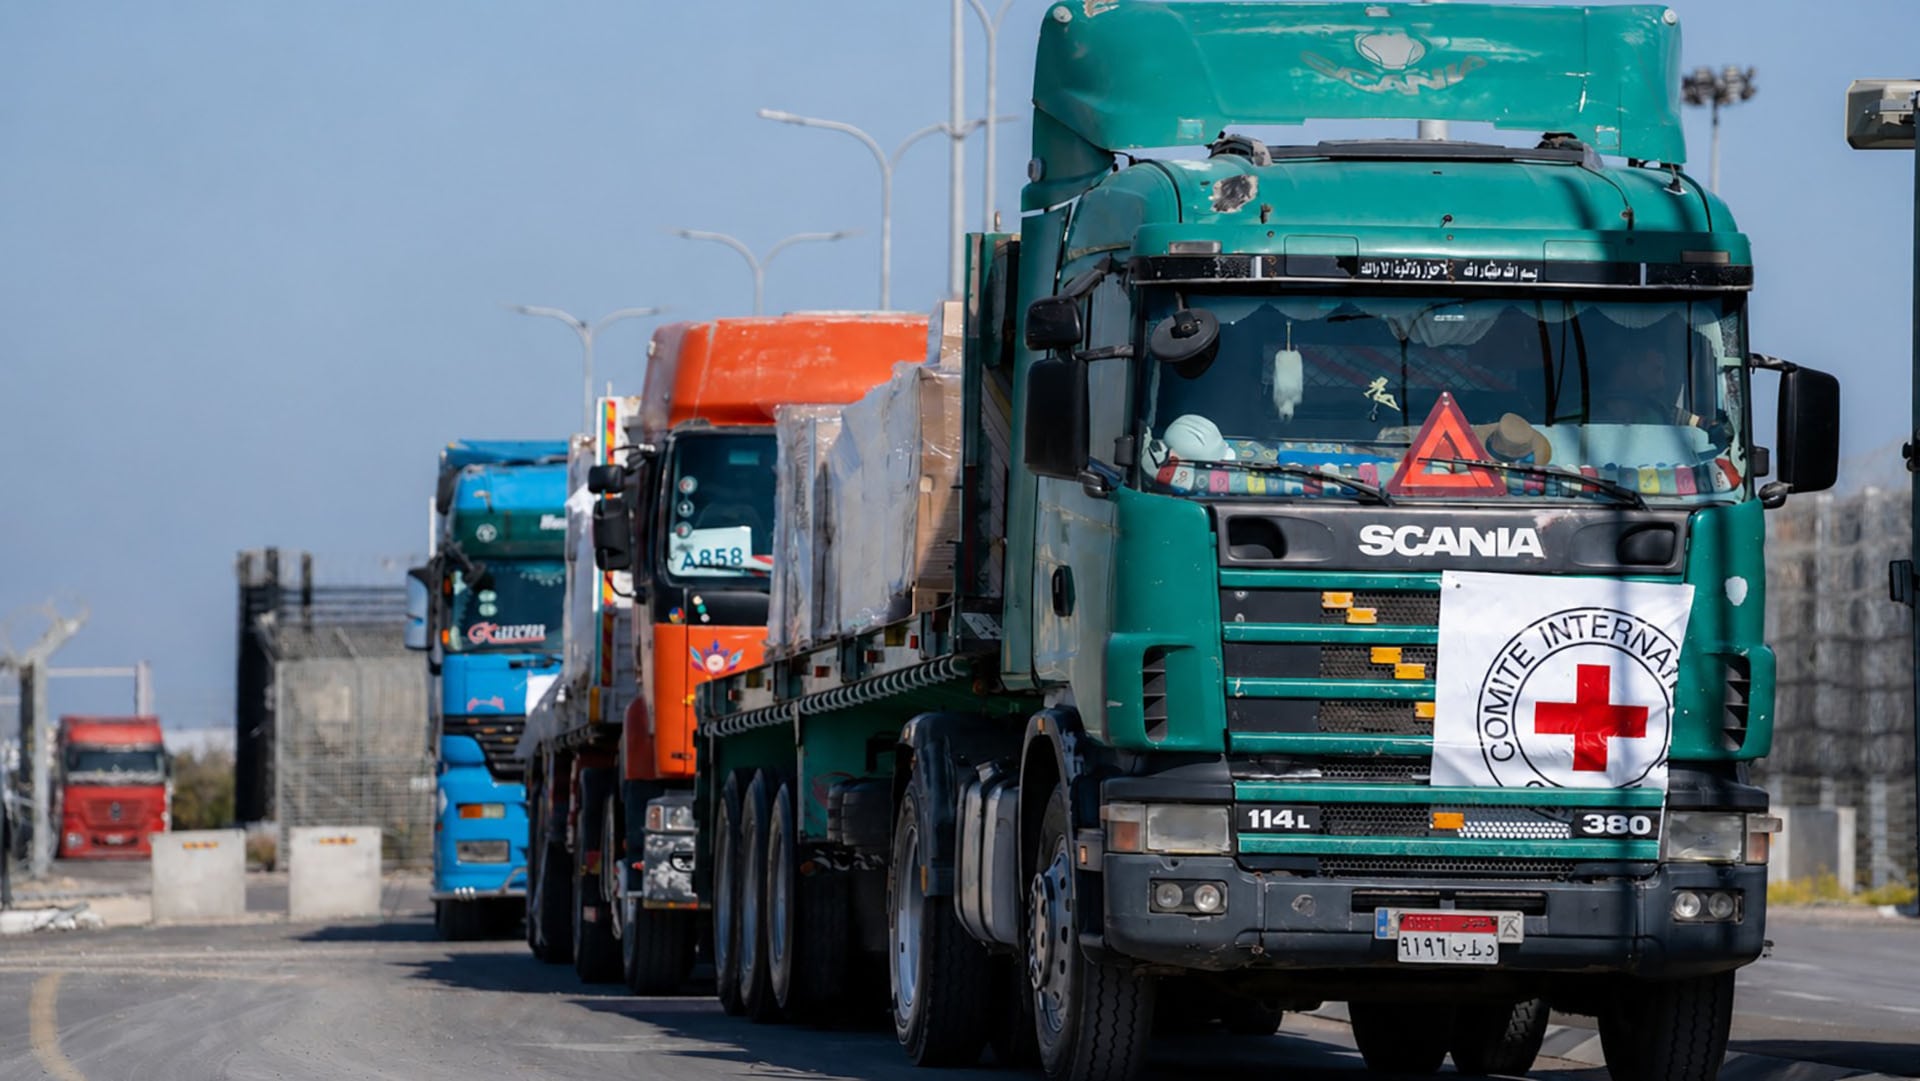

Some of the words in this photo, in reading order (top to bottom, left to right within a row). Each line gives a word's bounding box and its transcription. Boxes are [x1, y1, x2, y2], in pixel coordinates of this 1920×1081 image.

[1358, 524, 1546, 558] SCANIA
[1484, 642, 1535, 761] COMITE
[1582, 814, 1652, 835] 380
